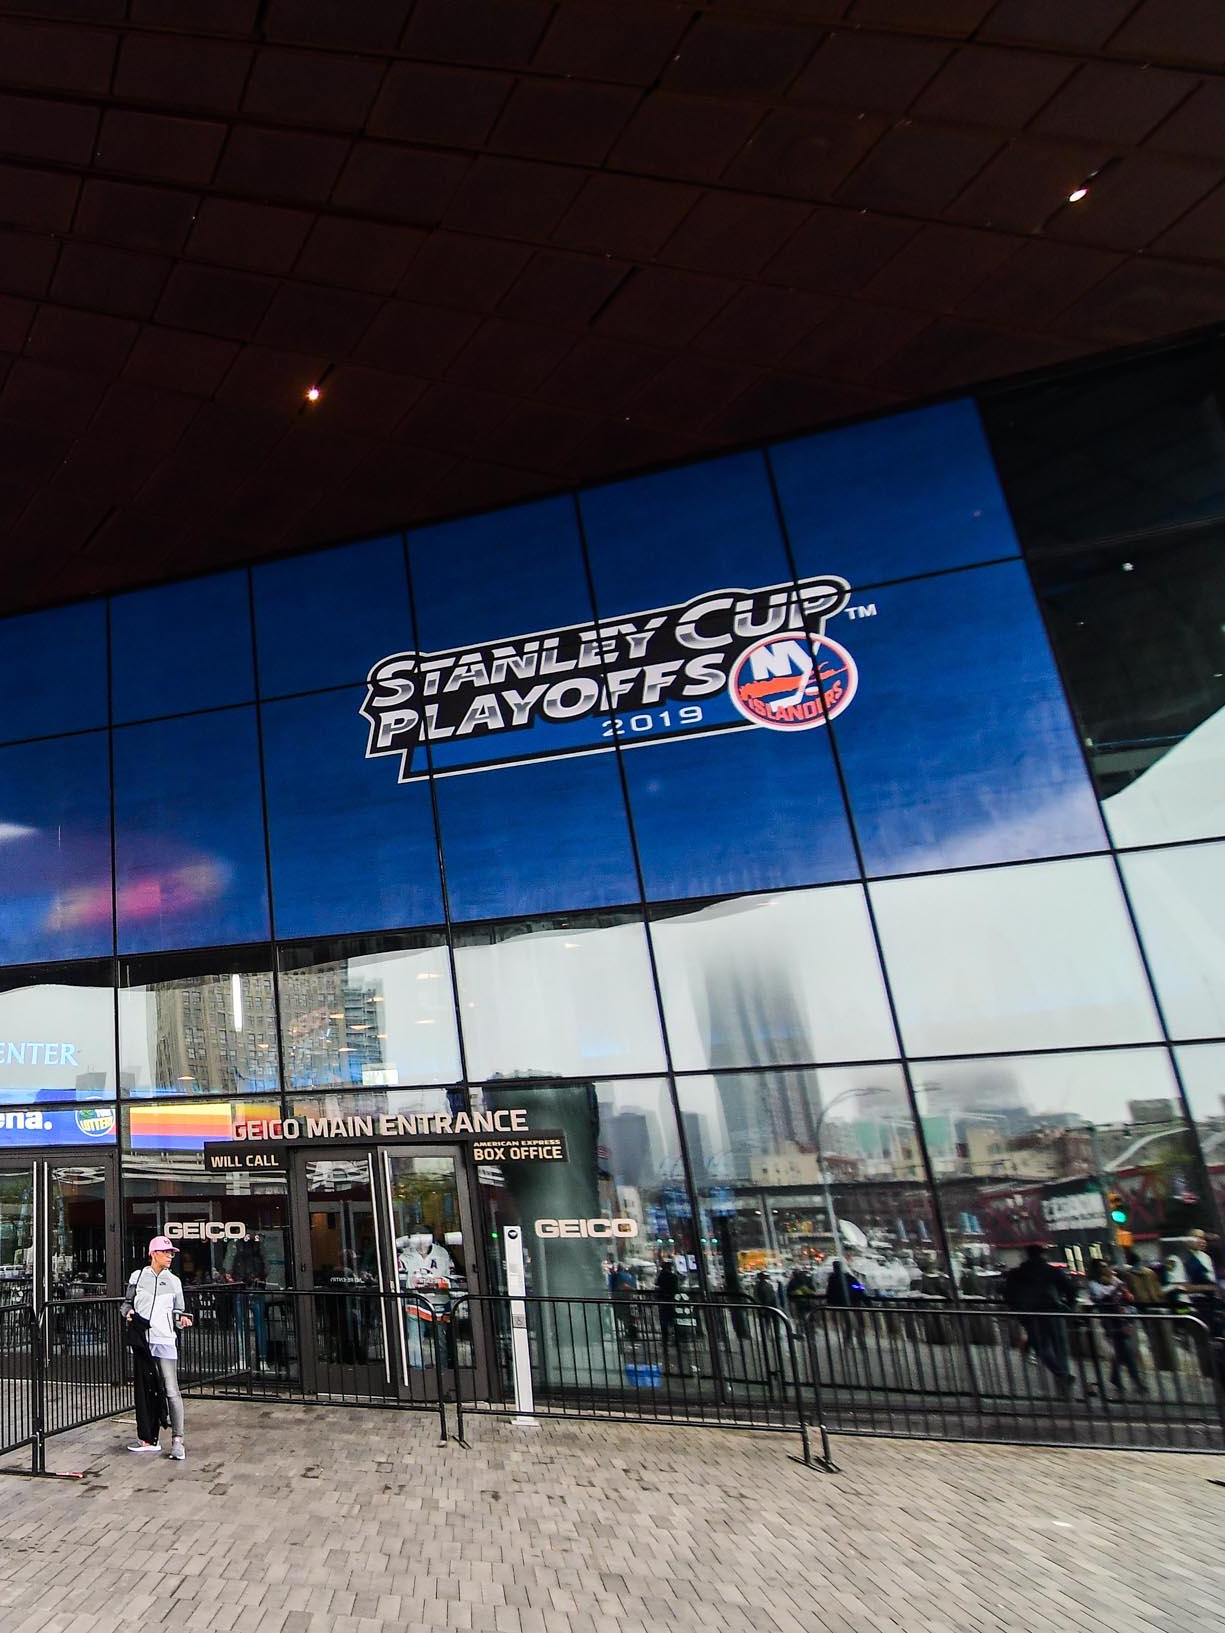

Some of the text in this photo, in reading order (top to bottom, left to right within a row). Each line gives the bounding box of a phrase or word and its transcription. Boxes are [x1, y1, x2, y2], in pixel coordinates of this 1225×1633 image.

[371, 584, 839, 707] STANLEY CUP
[376, 653, 726, 747] PLAYOFFS
[602, 706, 703, 736] 2019
[232, 1109, 529, 1141] GEICO MAIN ENTRANCE
[210, 1154, 279, 1168] WILL CALL
[473, 1146, 563, 1161] BOX OFFICE
[163, 1221, 246, 1239] GEICO
[535, 1218, 638, 1238] GEICO
